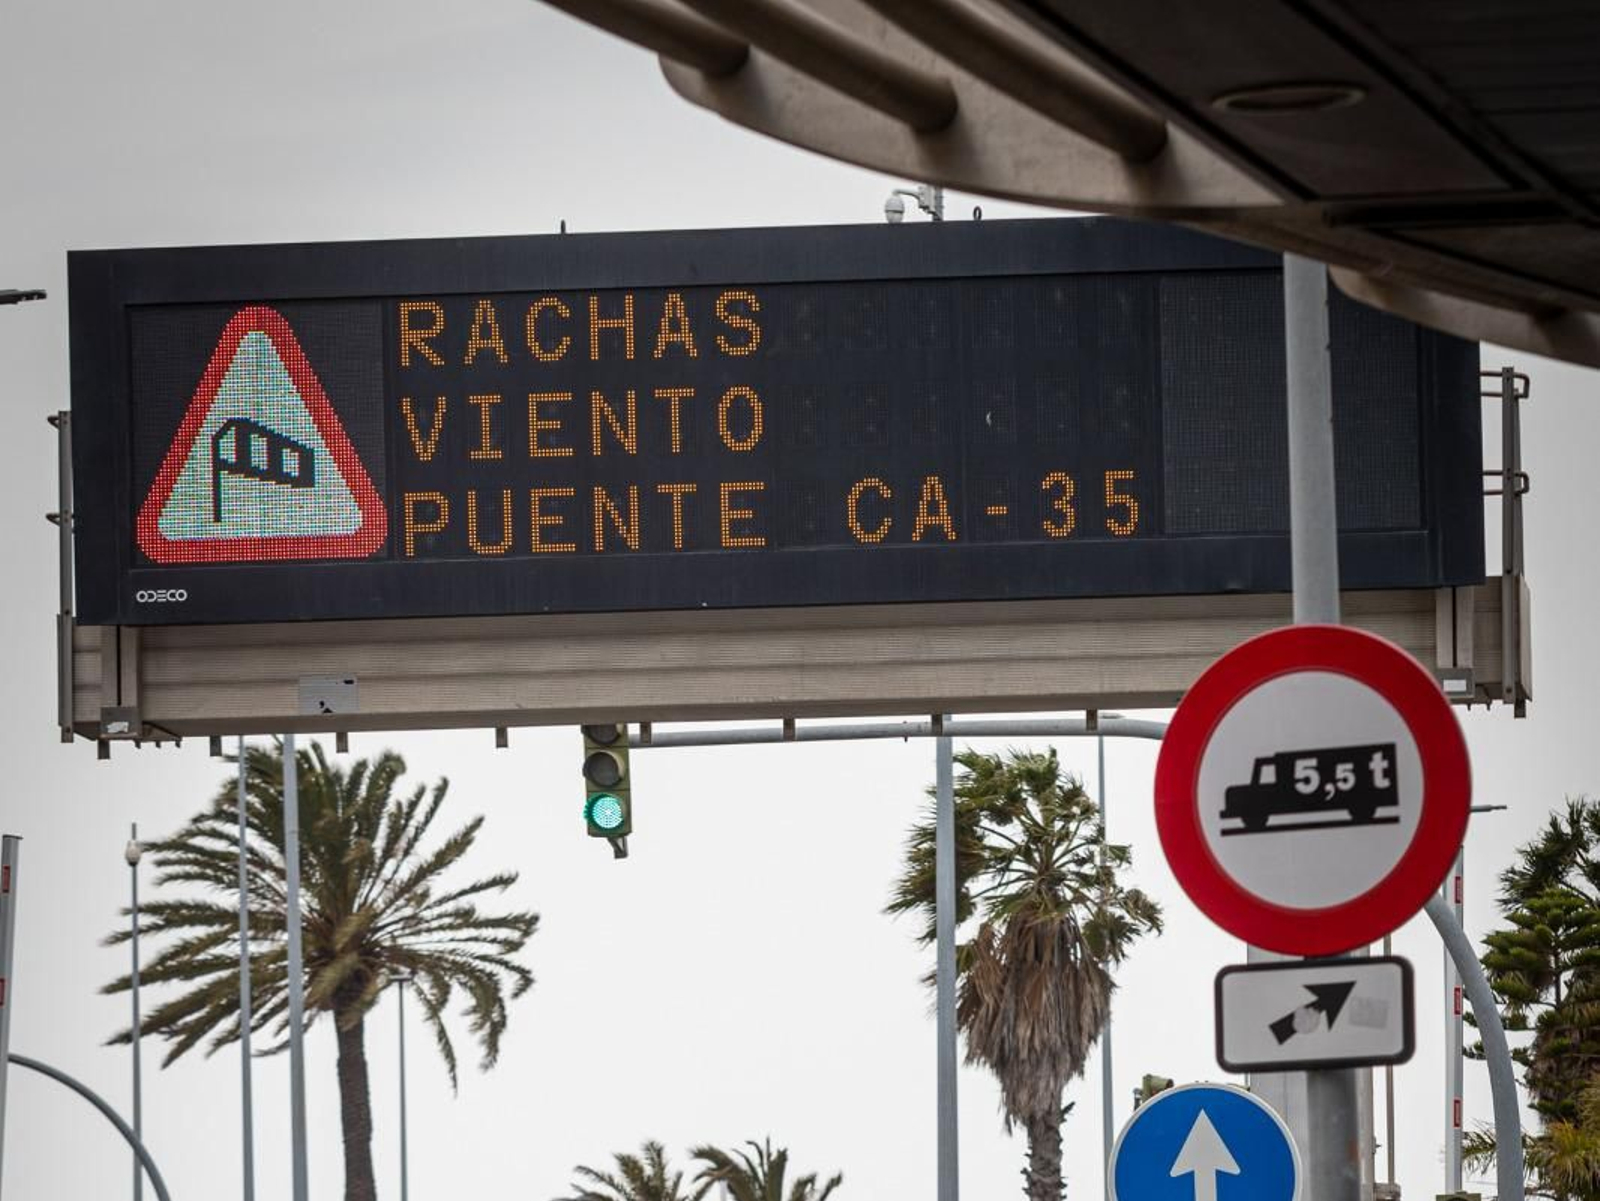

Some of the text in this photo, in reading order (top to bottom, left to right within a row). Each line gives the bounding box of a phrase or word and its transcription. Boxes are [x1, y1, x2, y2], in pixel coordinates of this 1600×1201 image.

[400, 290, 762, 366] RACHAS
[402, 385, 764, 461] VIENTO
[403, 481, 765, 555] PUENTE
[135, 588, 188, 603] ODECO
[1294, 750, 1392, 801] 5,5 t
